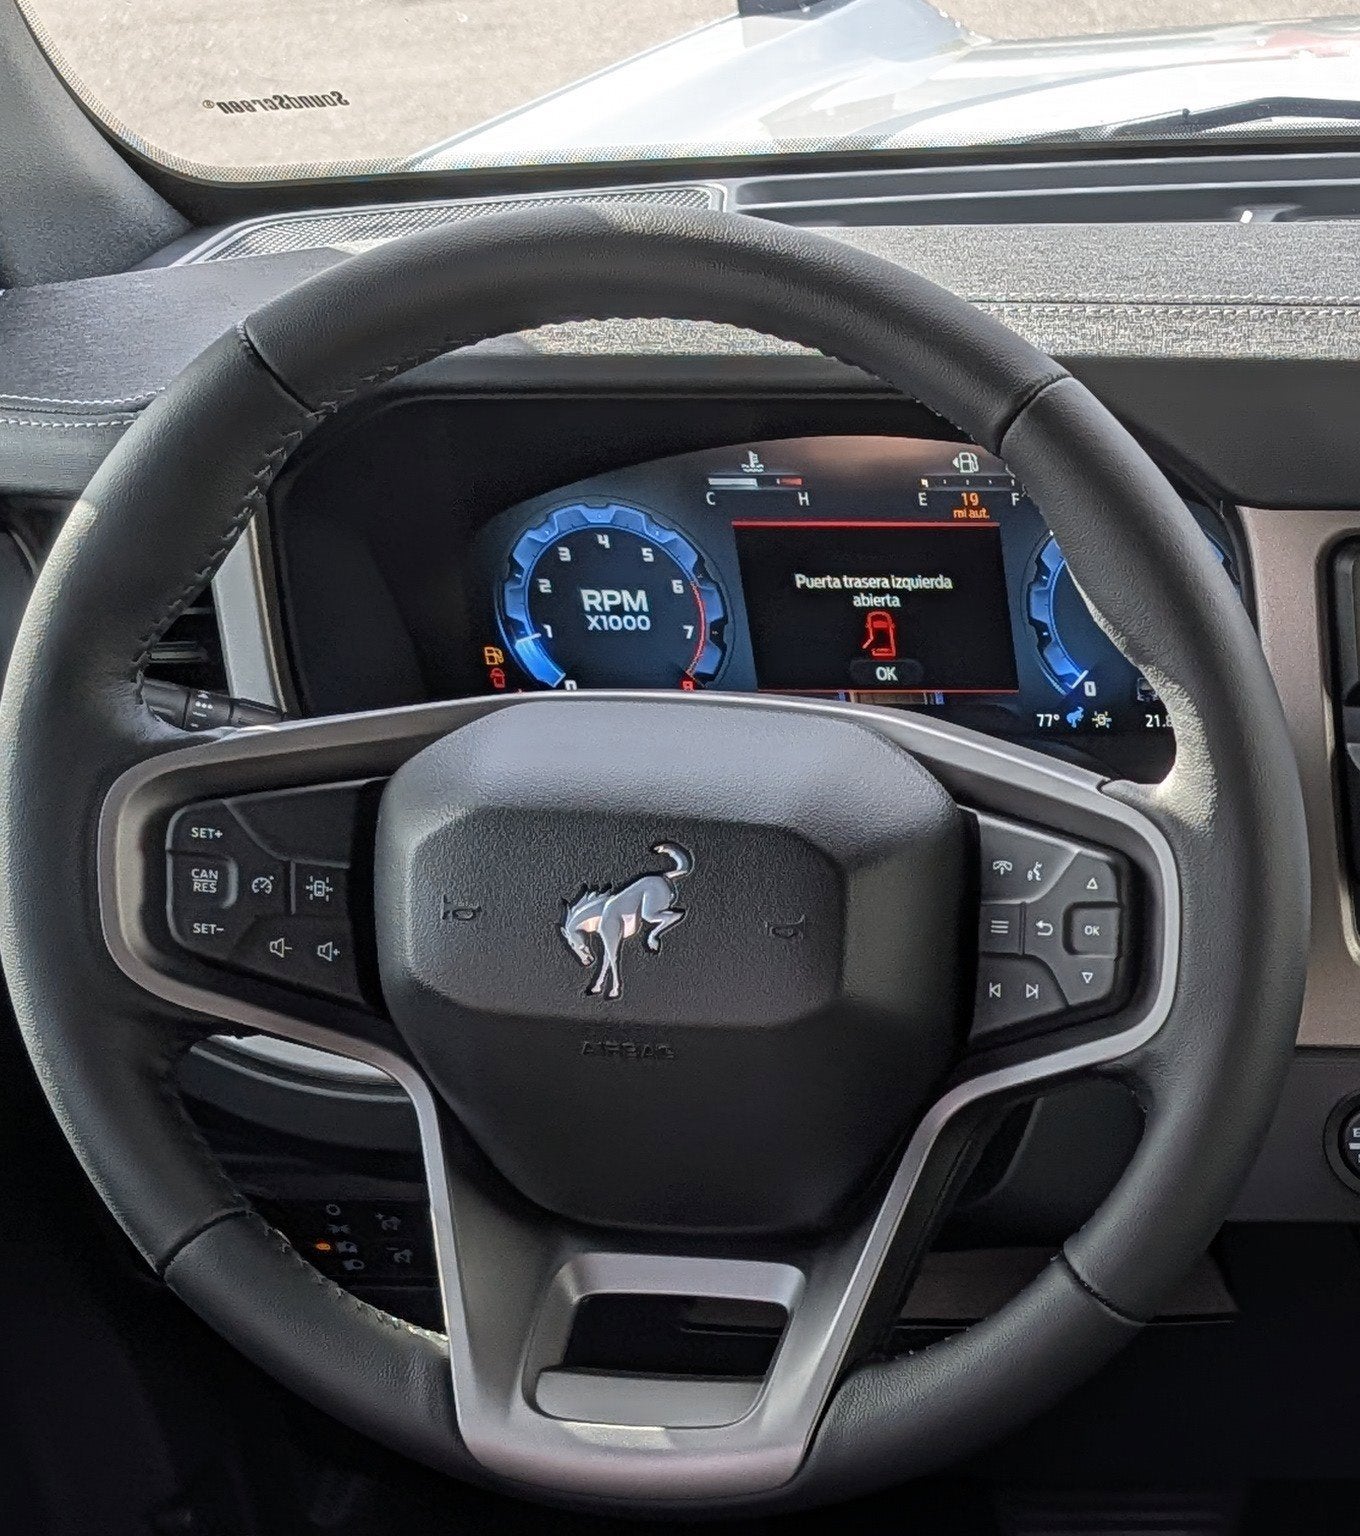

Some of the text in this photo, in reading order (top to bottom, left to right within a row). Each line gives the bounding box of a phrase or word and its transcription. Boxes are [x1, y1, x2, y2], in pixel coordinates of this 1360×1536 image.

[706, 492, 716, 506] C
[799, 492, 810, 506] H
[918, 493, 928, 506] E
[961, 493, 979, 507] 19
[1011, 493, 1021, 505] F
[596, 533, 610, 549] 4
[558, 546, 572, 561] 3
[641, 547, 654, 562] 5
[537, 578, 552, 593] 2
[671, 579, 685, 594] 6
[795, 574, 953, 591] Puerta trasera izquierda
[580, 589, 649, 612] RPM
[852, 593, 900, 607] abierta
[585, 615, 650, 630] X1000
[543, 624, 553, 638] 1
[683, 625, 694, 639] 7
[876, 667, 898, 681] OK
[1083, 680, 1097, 697] 0
[191, 827, 223, 839] SET+
[191, 868, 218, 880] CAN
[193, 882, 218, 894] RES
[1084, 925, 1101, 936] OK
